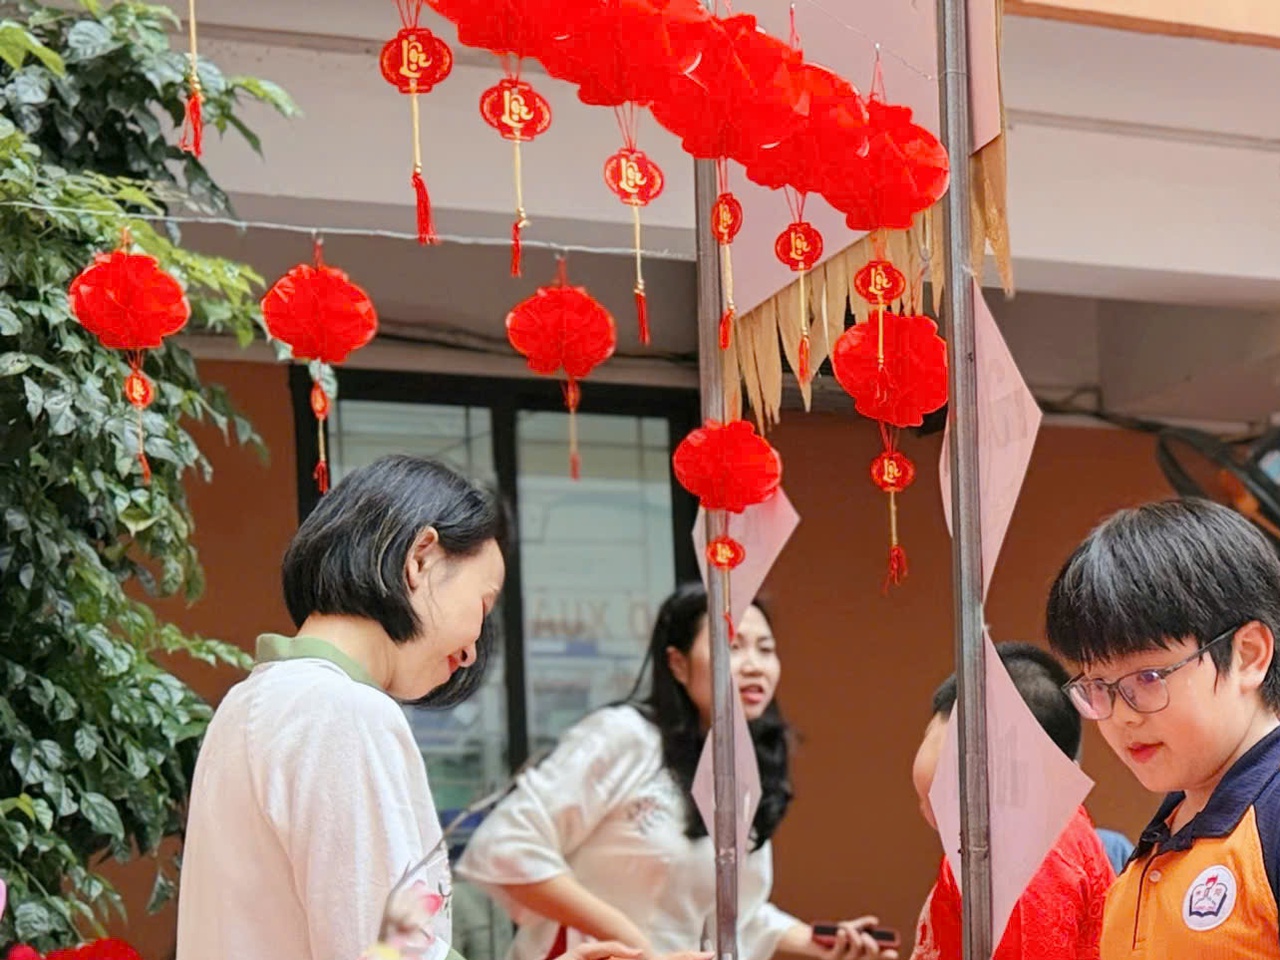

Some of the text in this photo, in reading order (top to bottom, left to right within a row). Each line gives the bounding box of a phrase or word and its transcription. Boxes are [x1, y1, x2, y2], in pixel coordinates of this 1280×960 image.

[399, 39, 433, 78] Lộc
[501, 90, 535, 128] Lộc
[619, 158, 647, 193] Lộc
[790, 231, 811, 260] Lộc
[869, 267, 892, 295] Lộc
[883, 458, 902, 483] Lộc
